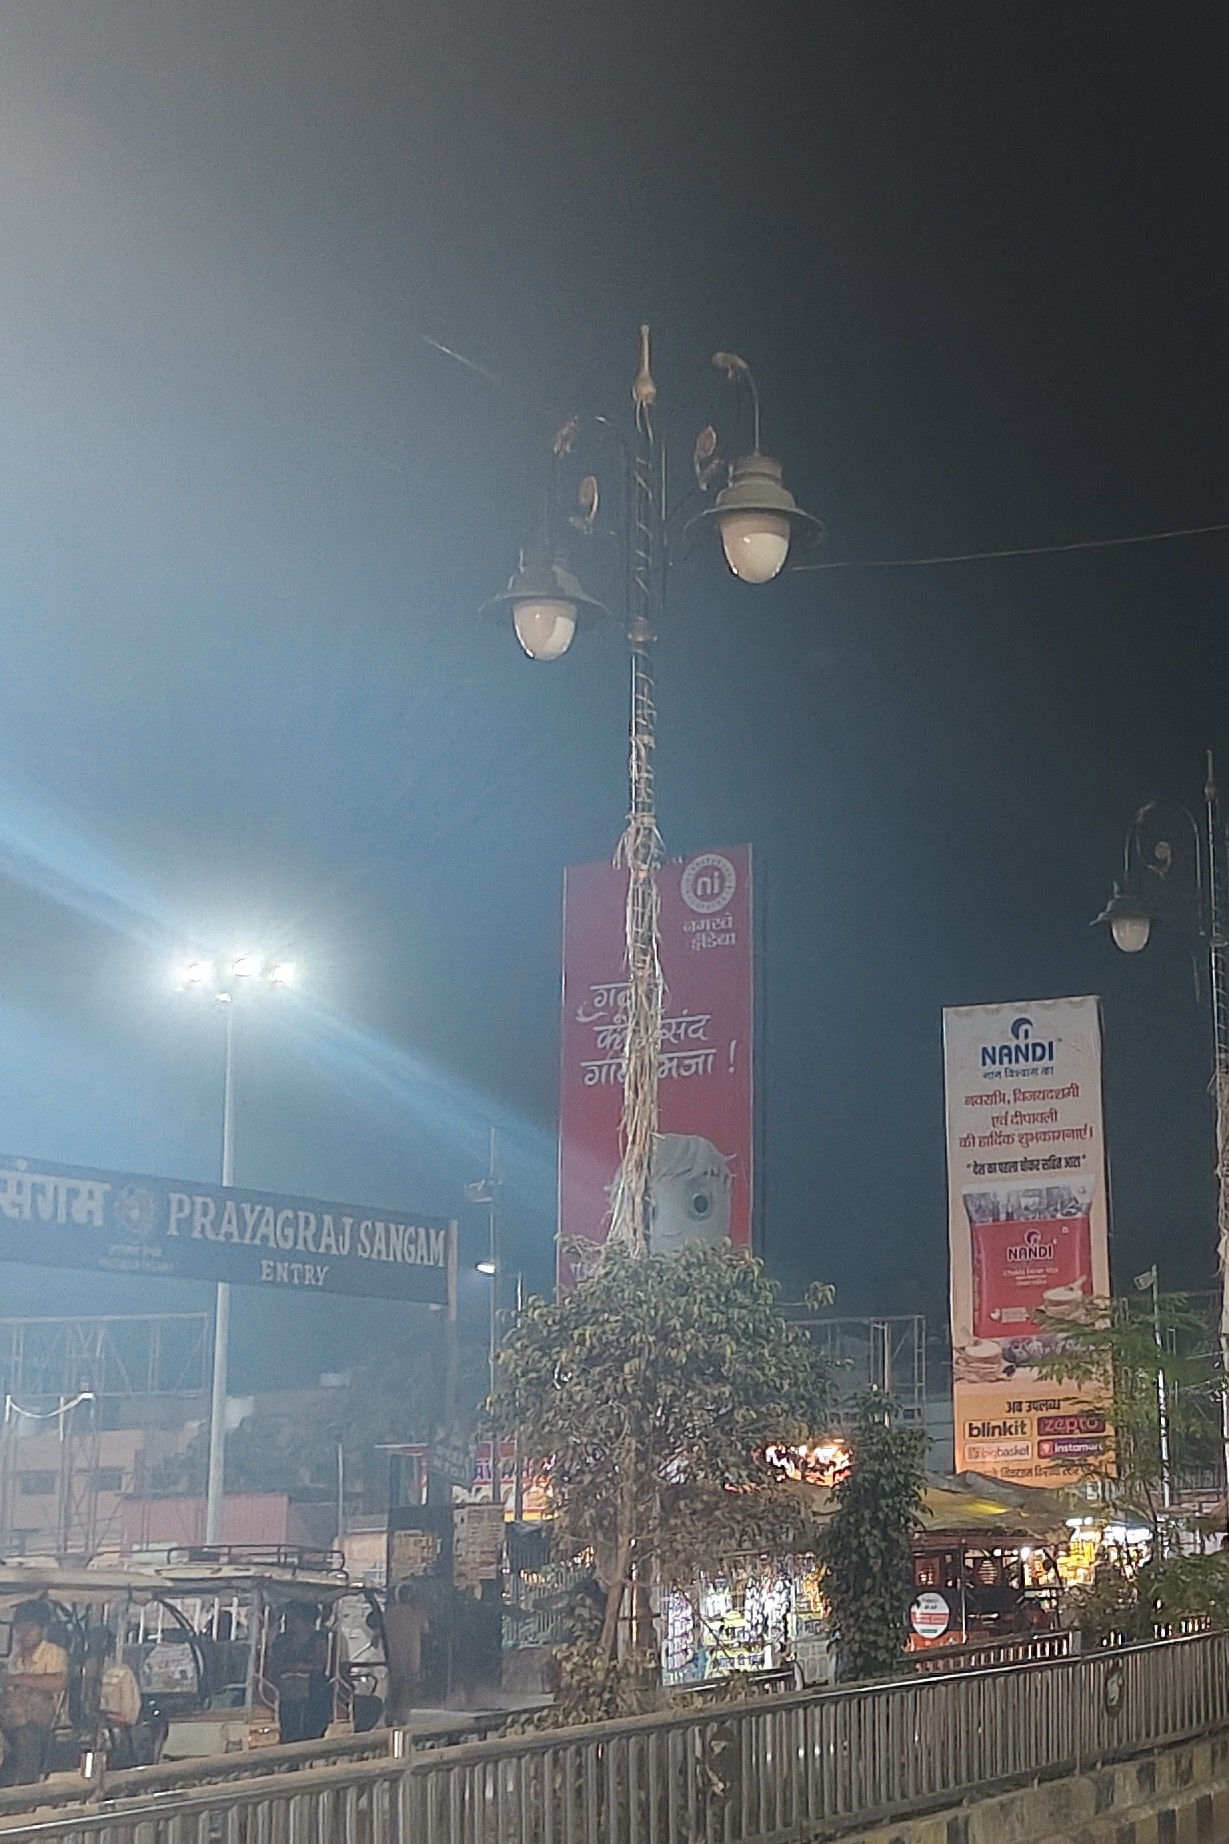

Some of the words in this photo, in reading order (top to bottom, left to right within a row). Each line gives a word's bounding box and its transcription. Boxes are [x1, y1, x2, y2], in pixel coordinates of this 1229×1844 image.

[981, 1041, 1054, 1067] NANDI
[1010, 1107, 1058, 1126] दीपावली
[959, 1132, 976, 1148] की
[978, 1130, 1016, 1148] हार्दिक
[167, 1192, 354, 1257] PRAYAGRAJ
[357, 1219, 446, 1268] SANGAM
[1007, 1244, 1053, 1262] NANDI
[260, 1260, 331, 1286] ENTRY
[1006, 1401, 1023, 1414] अब
[968, 1420, 1027, 1437] blinkit
[981, 1446, 1030, 1459] bigbasket
